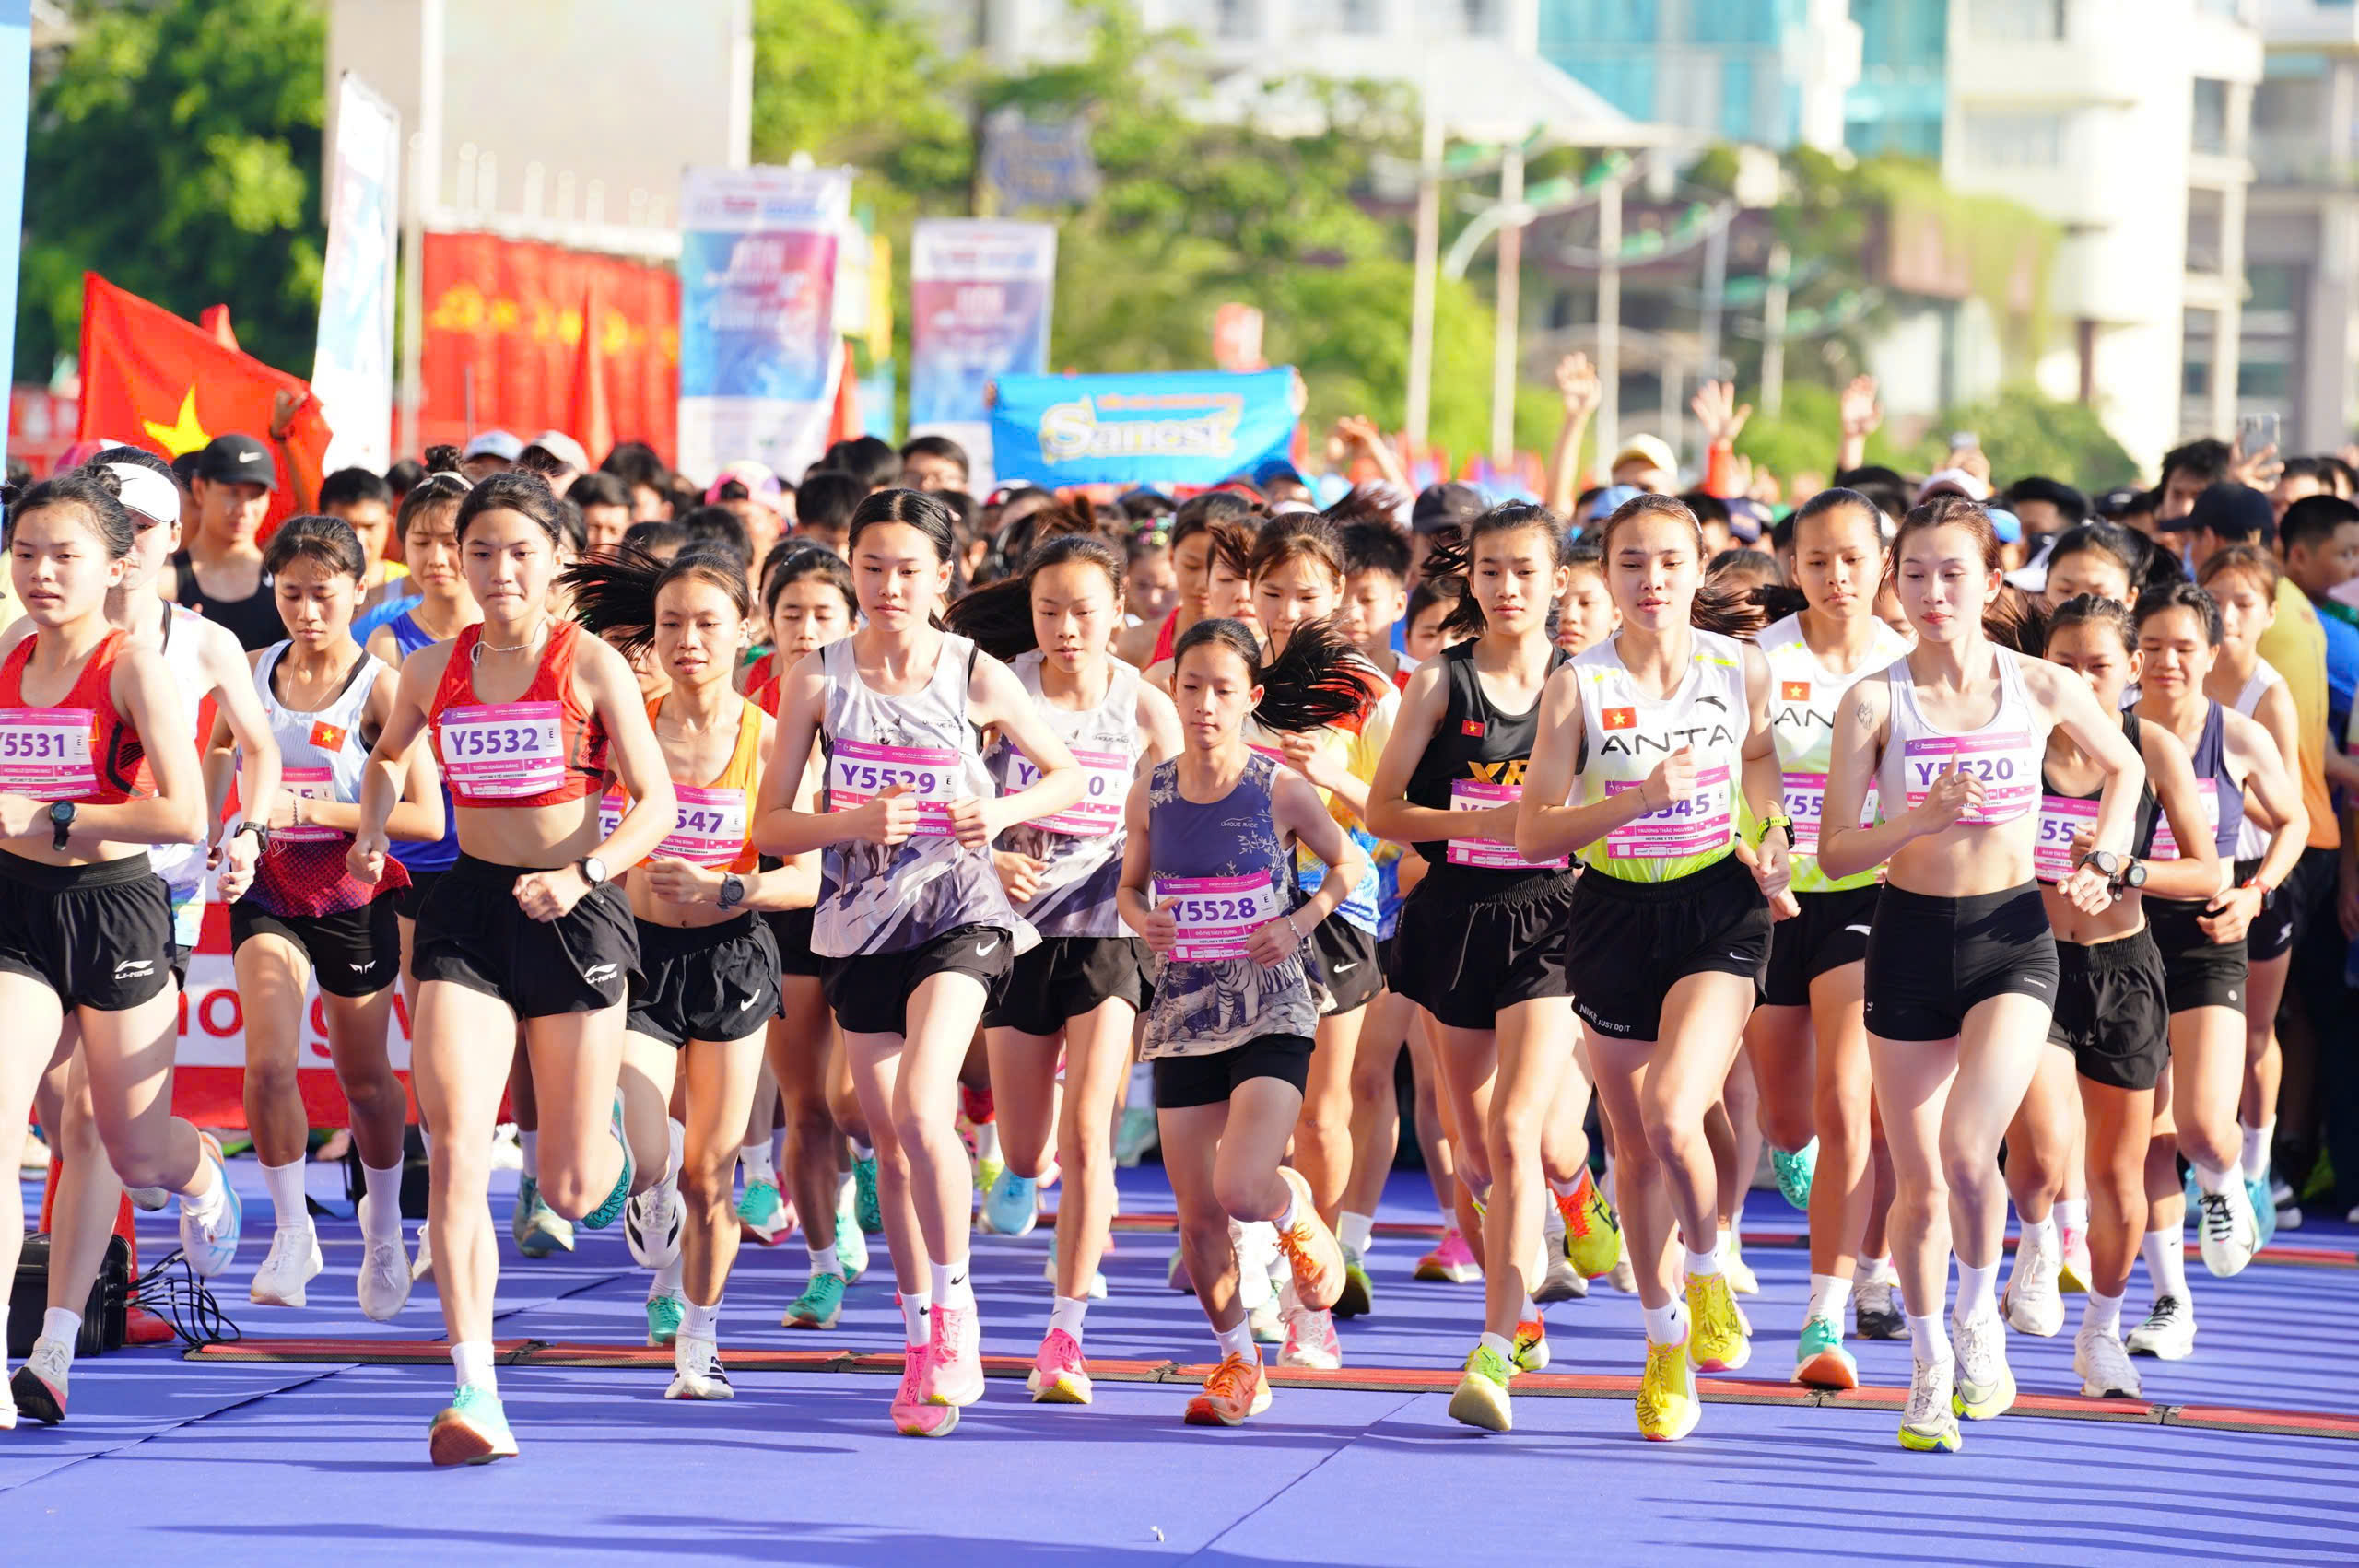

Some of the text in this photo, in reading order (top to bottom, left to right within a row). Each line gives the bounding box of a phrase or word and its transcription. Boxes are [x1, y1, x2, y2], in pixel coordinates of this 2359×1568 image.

[1774, 707, 1837, 729] AN
[0, 732, 65, 758] 5531
[449, 727, 540, 756] Y5532
[1601, 724, 1734, 756] ANTA
[839, 762, 937, 795] Y5529
[675, 808, 724, 834] 547
[1171, 897, 1257, 922] Y5528
[1579, 1003, 1598, 1023] NIKE
[1597, 1019, 1614, 1030] JUST
[1614, 1024, 1624, 1032] DO
